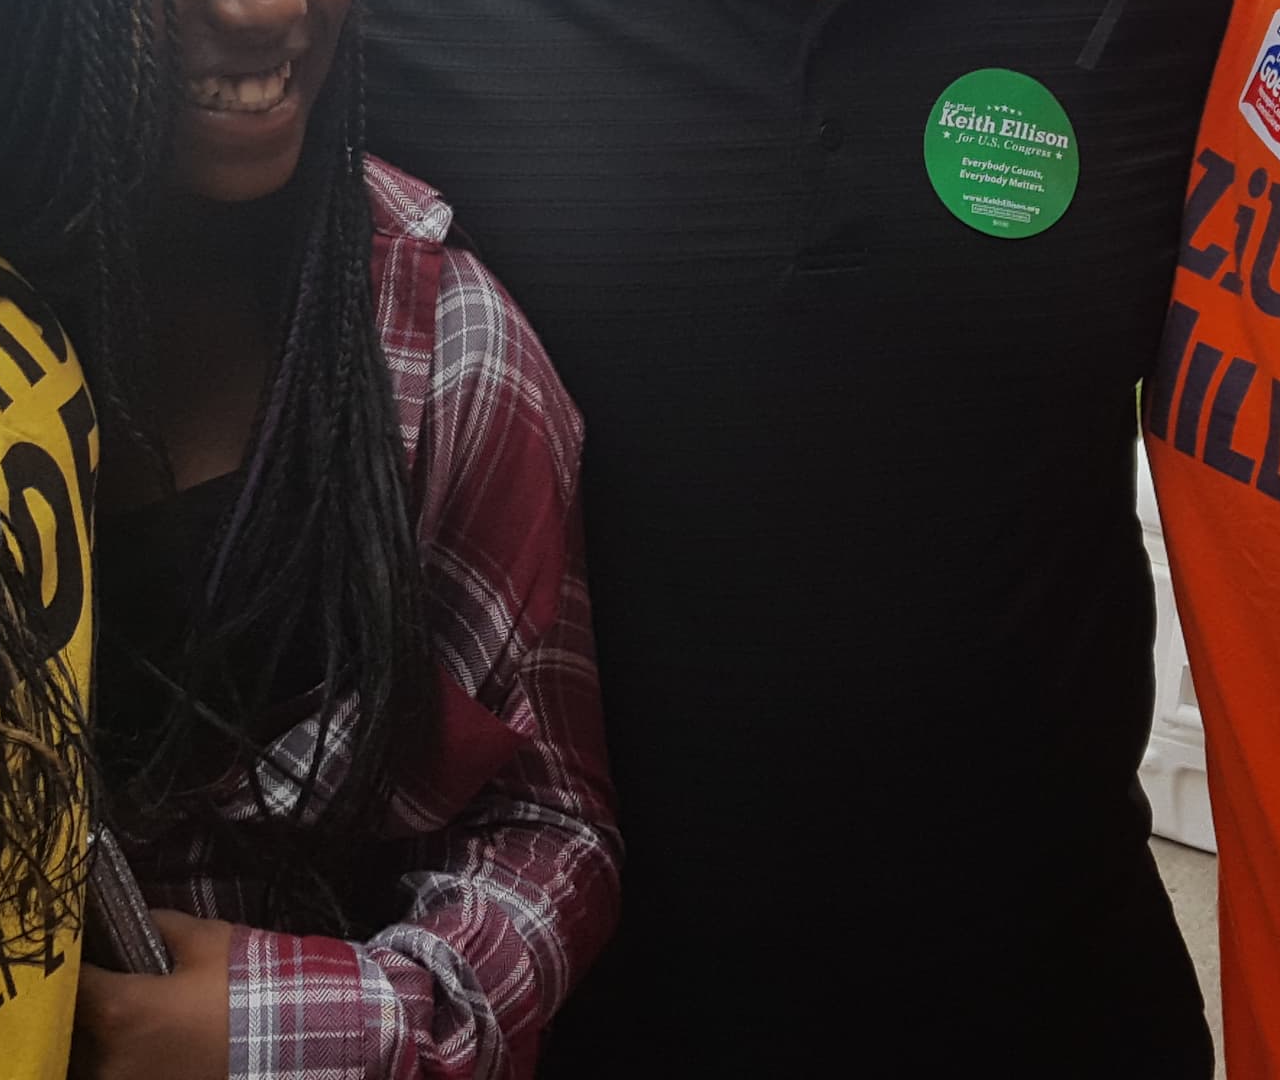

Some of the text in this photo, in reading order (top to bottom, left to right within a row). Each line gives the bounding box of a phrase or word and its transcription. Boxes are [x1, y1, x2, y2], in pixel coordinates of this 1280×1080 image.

[938, 108, 1069, 149] Keith Ellison
[955, 133, 1052, 158] for U.S. Congress
[961, 157, 1010, 174] Everybody
[960, 169, 1045, 193] Everybody Matters.
